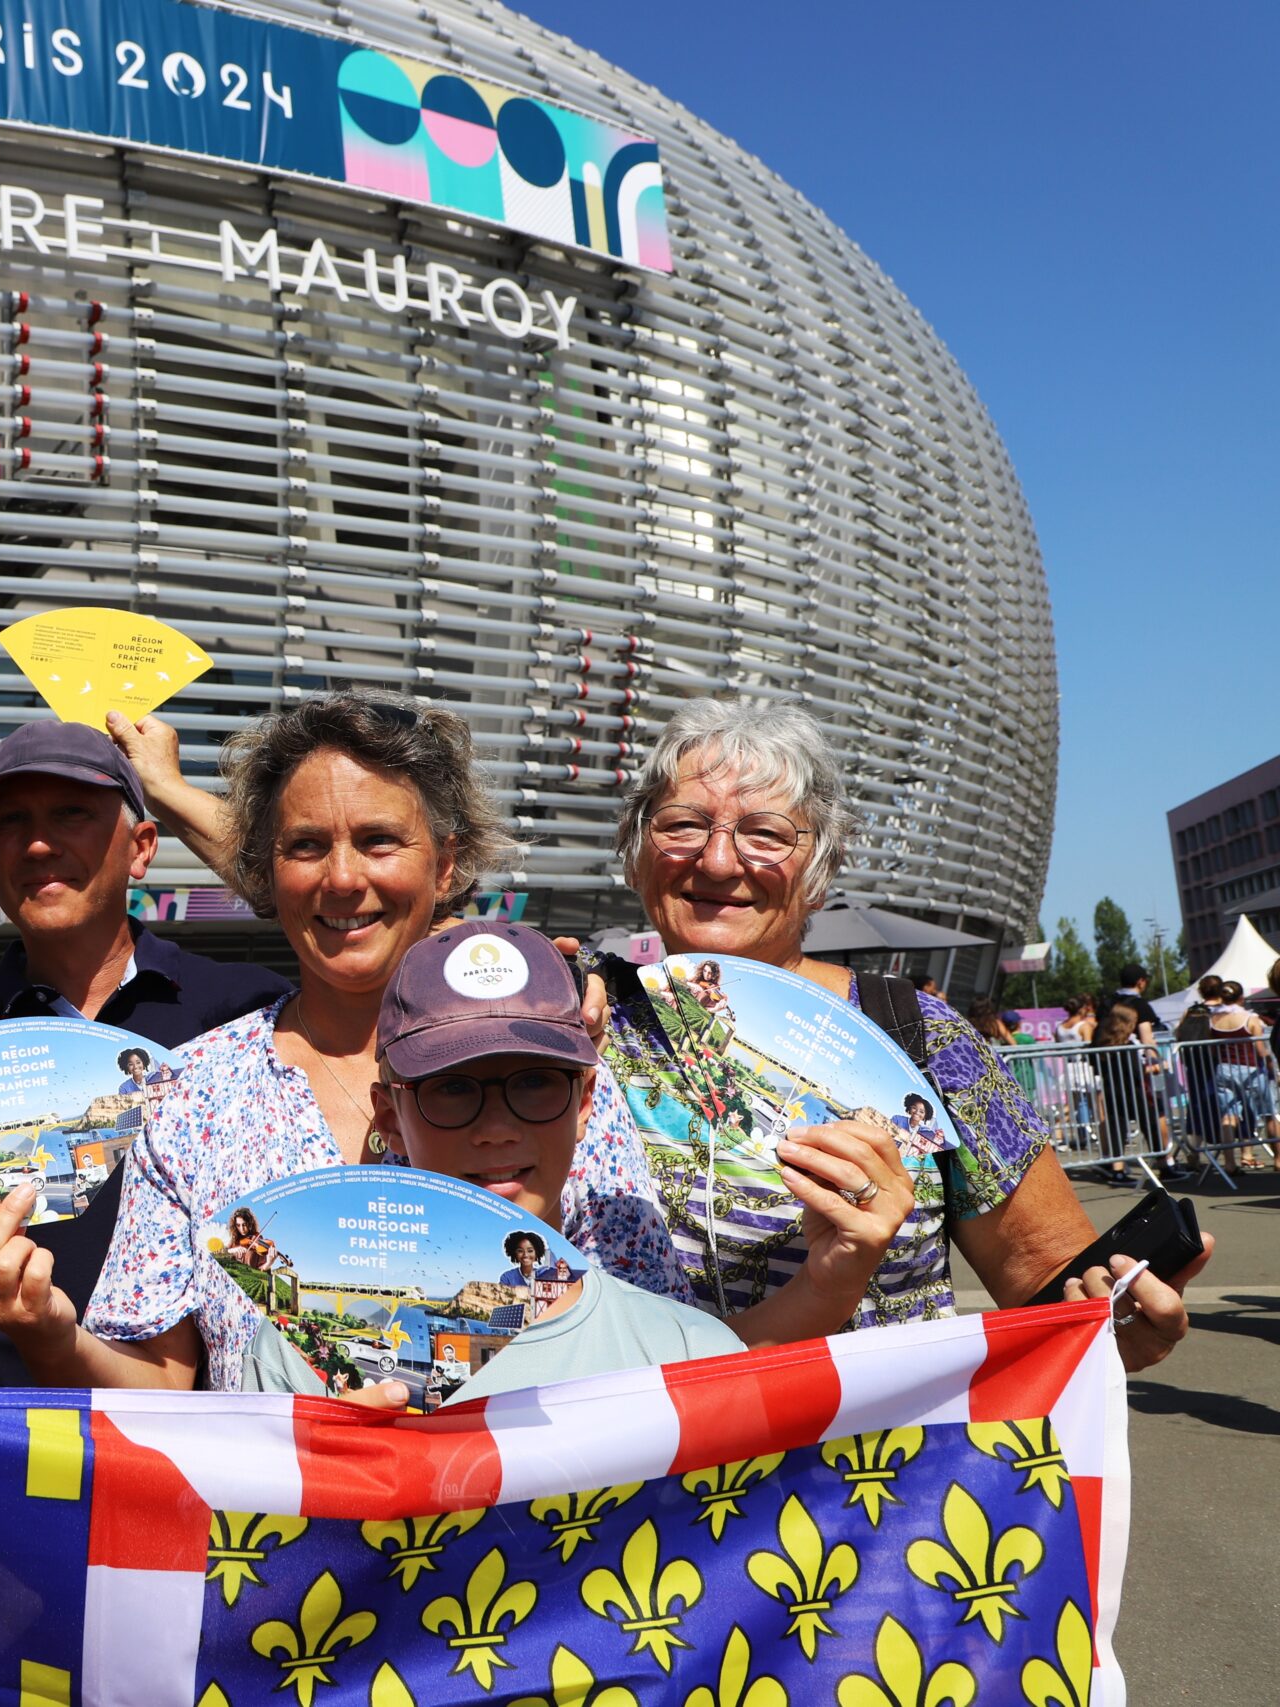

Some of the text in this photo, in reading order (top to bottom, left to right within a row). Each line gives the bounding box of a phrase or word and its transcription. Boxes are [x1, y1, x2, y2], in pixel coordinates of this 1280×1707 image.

[115, 40, 293, 119] 2024
[220, 220, 577, 351] MAUROY
[113, 643, 164, 654] BOURGOGNE
[118, 654, 156, 663] FRANCHE
[785, 1011, 856, 1060] BOURGOGNE
[788, 1028, 842, 1065] FRANCHE
[338, 1217, 429, 1235] BOURGOGNE
[350, 1236, 417, 1252] FRANCHE
